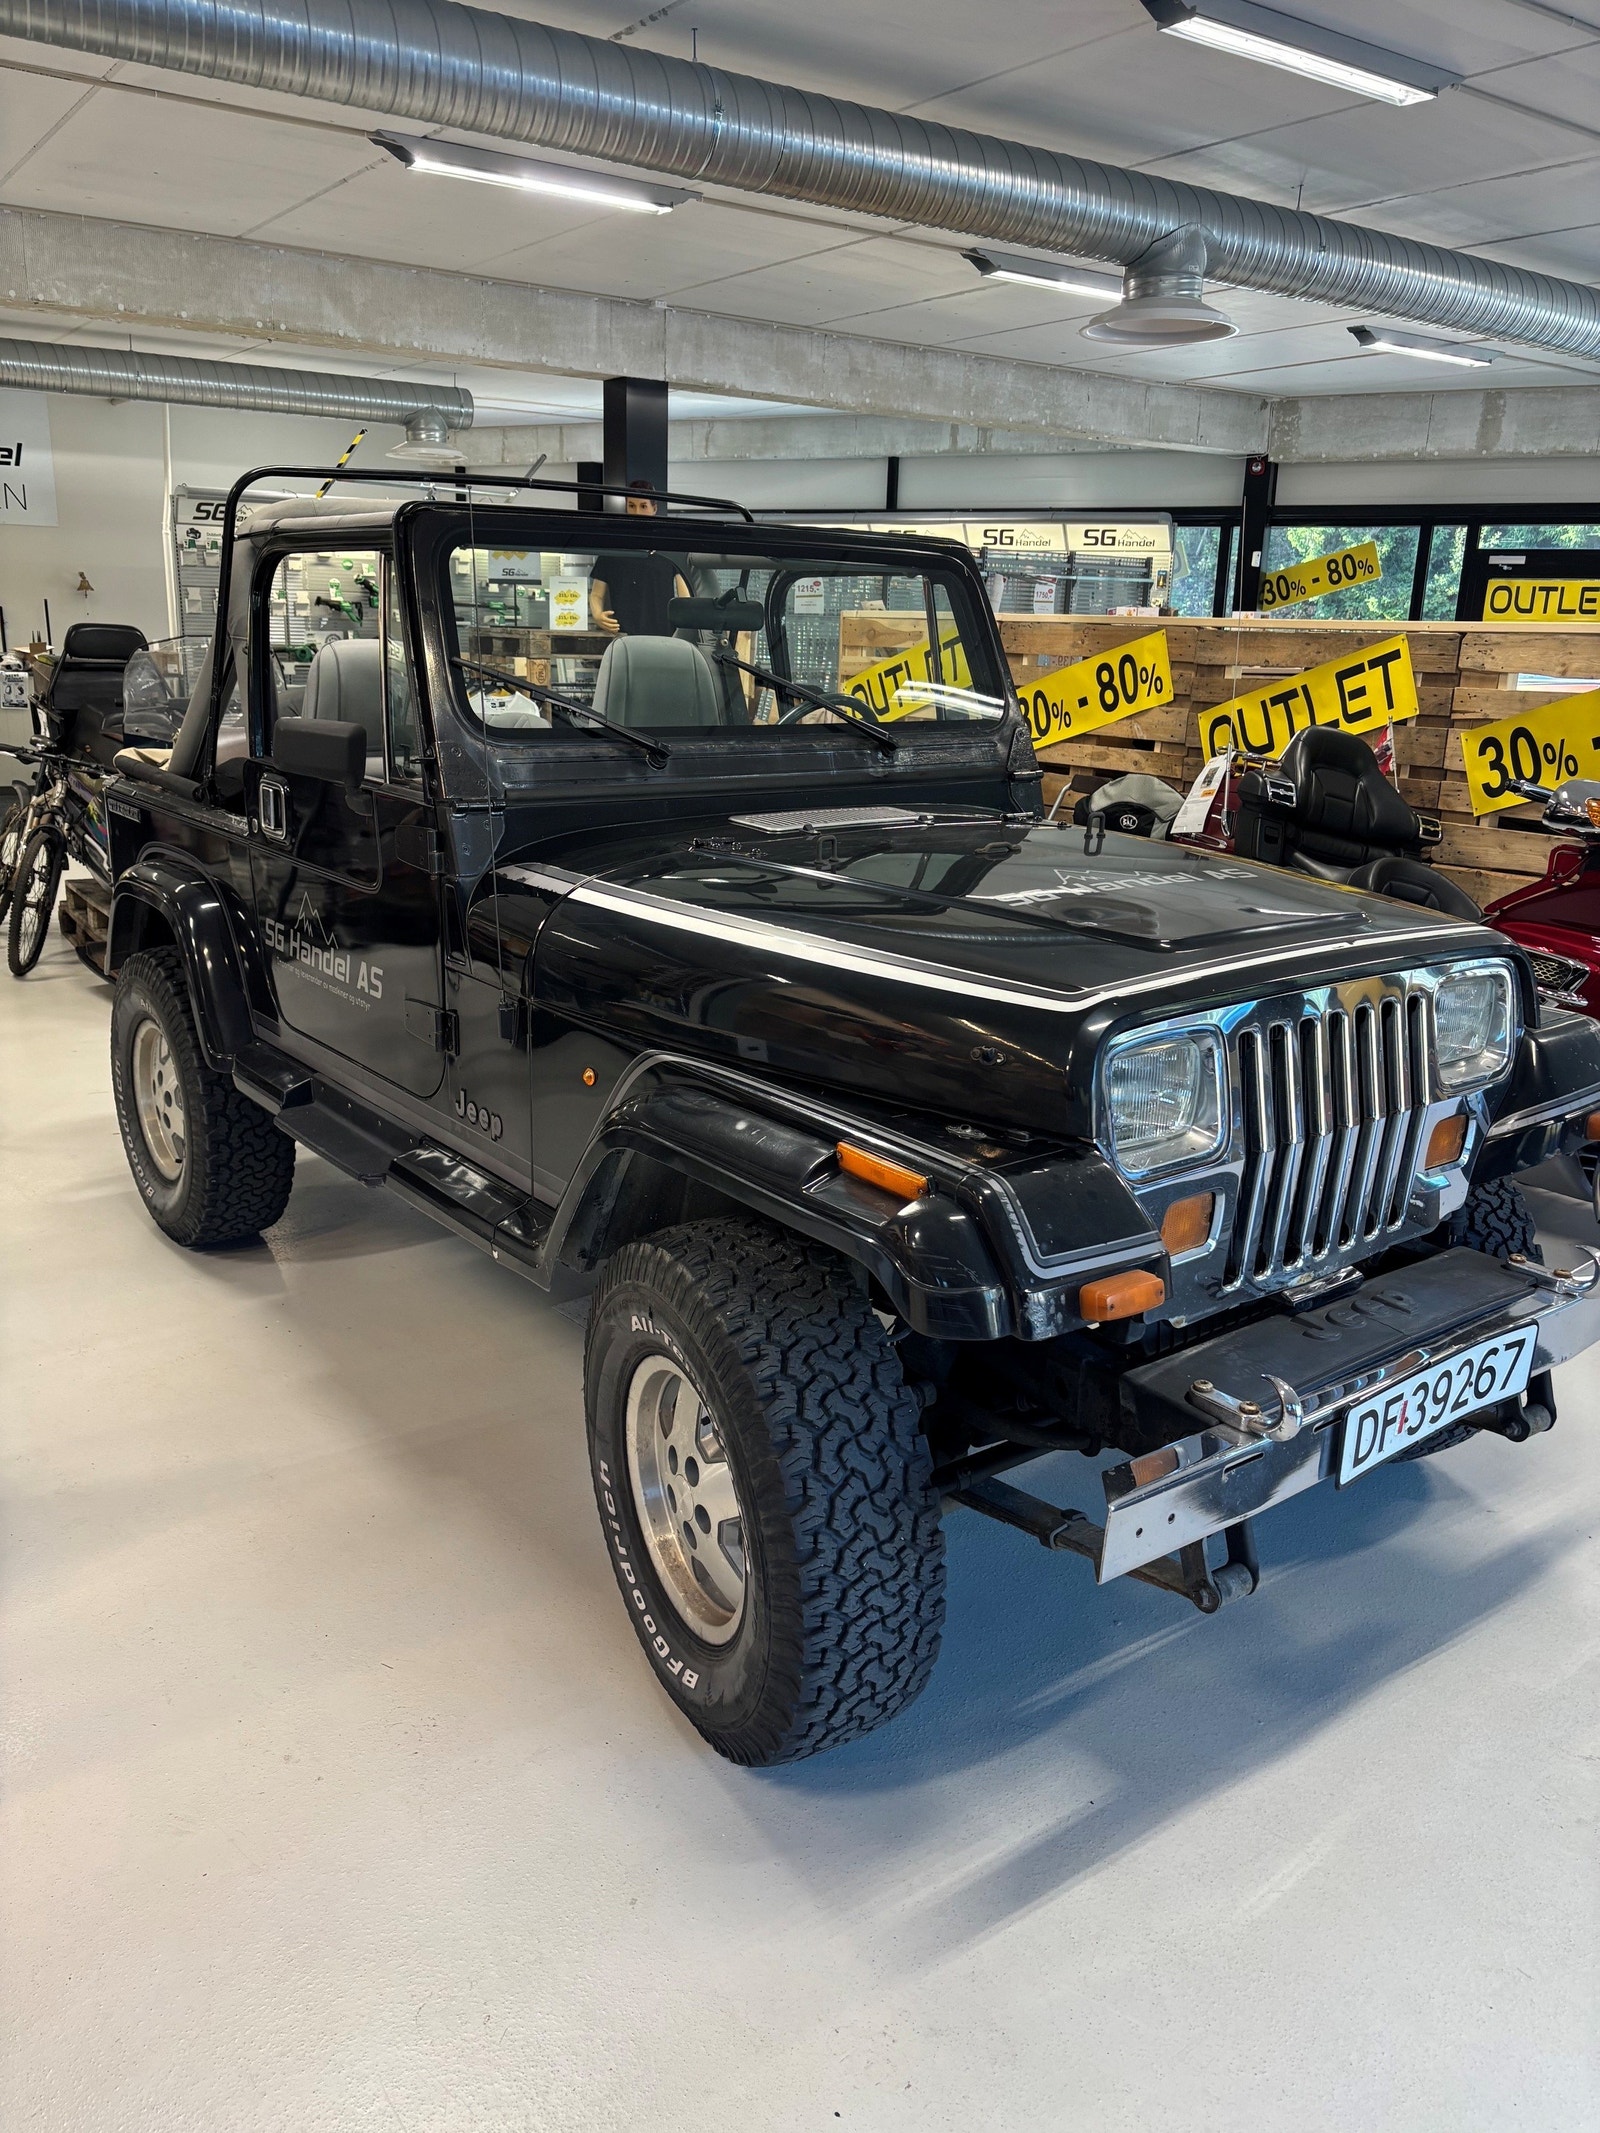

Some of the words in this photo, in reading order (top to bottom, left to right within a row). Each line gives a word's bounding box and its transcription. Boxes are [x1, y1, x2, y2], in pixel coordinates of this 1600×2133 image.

[0, 483, 27, 510] N
[982, 528, 1015, 546] SG
[1015, 537, 1051, 548] Handel
[1083, 528, 1117, 547] SG
[1117, 537, 1156, 548] Handel
[1262, 574, 1307, 606] 30%
[1326, 554, 1374, 586] 80%
[1489, 585, 1600, 615] OUTLE
[1096, 654, 1163, 713] 80%
[1208, 648, 1402, 754] OUTLET
[1478, 726, 1579, 799] 30%
[1056, 871, 1205, 896] Handel
[1204, 868, 1259, 880] AS
[264, 917, 285, 953] SG
[289, 928, 351, 984] Handel
[356, 961, 384, 999] AS
[454, 1088, 503, 1140] Jeep
[1352, 1393, 1405, 1469] DF
[1405, 1338, 1526, 1436] 39267
[598, 1459, 700, 1690] BFGoodrich
